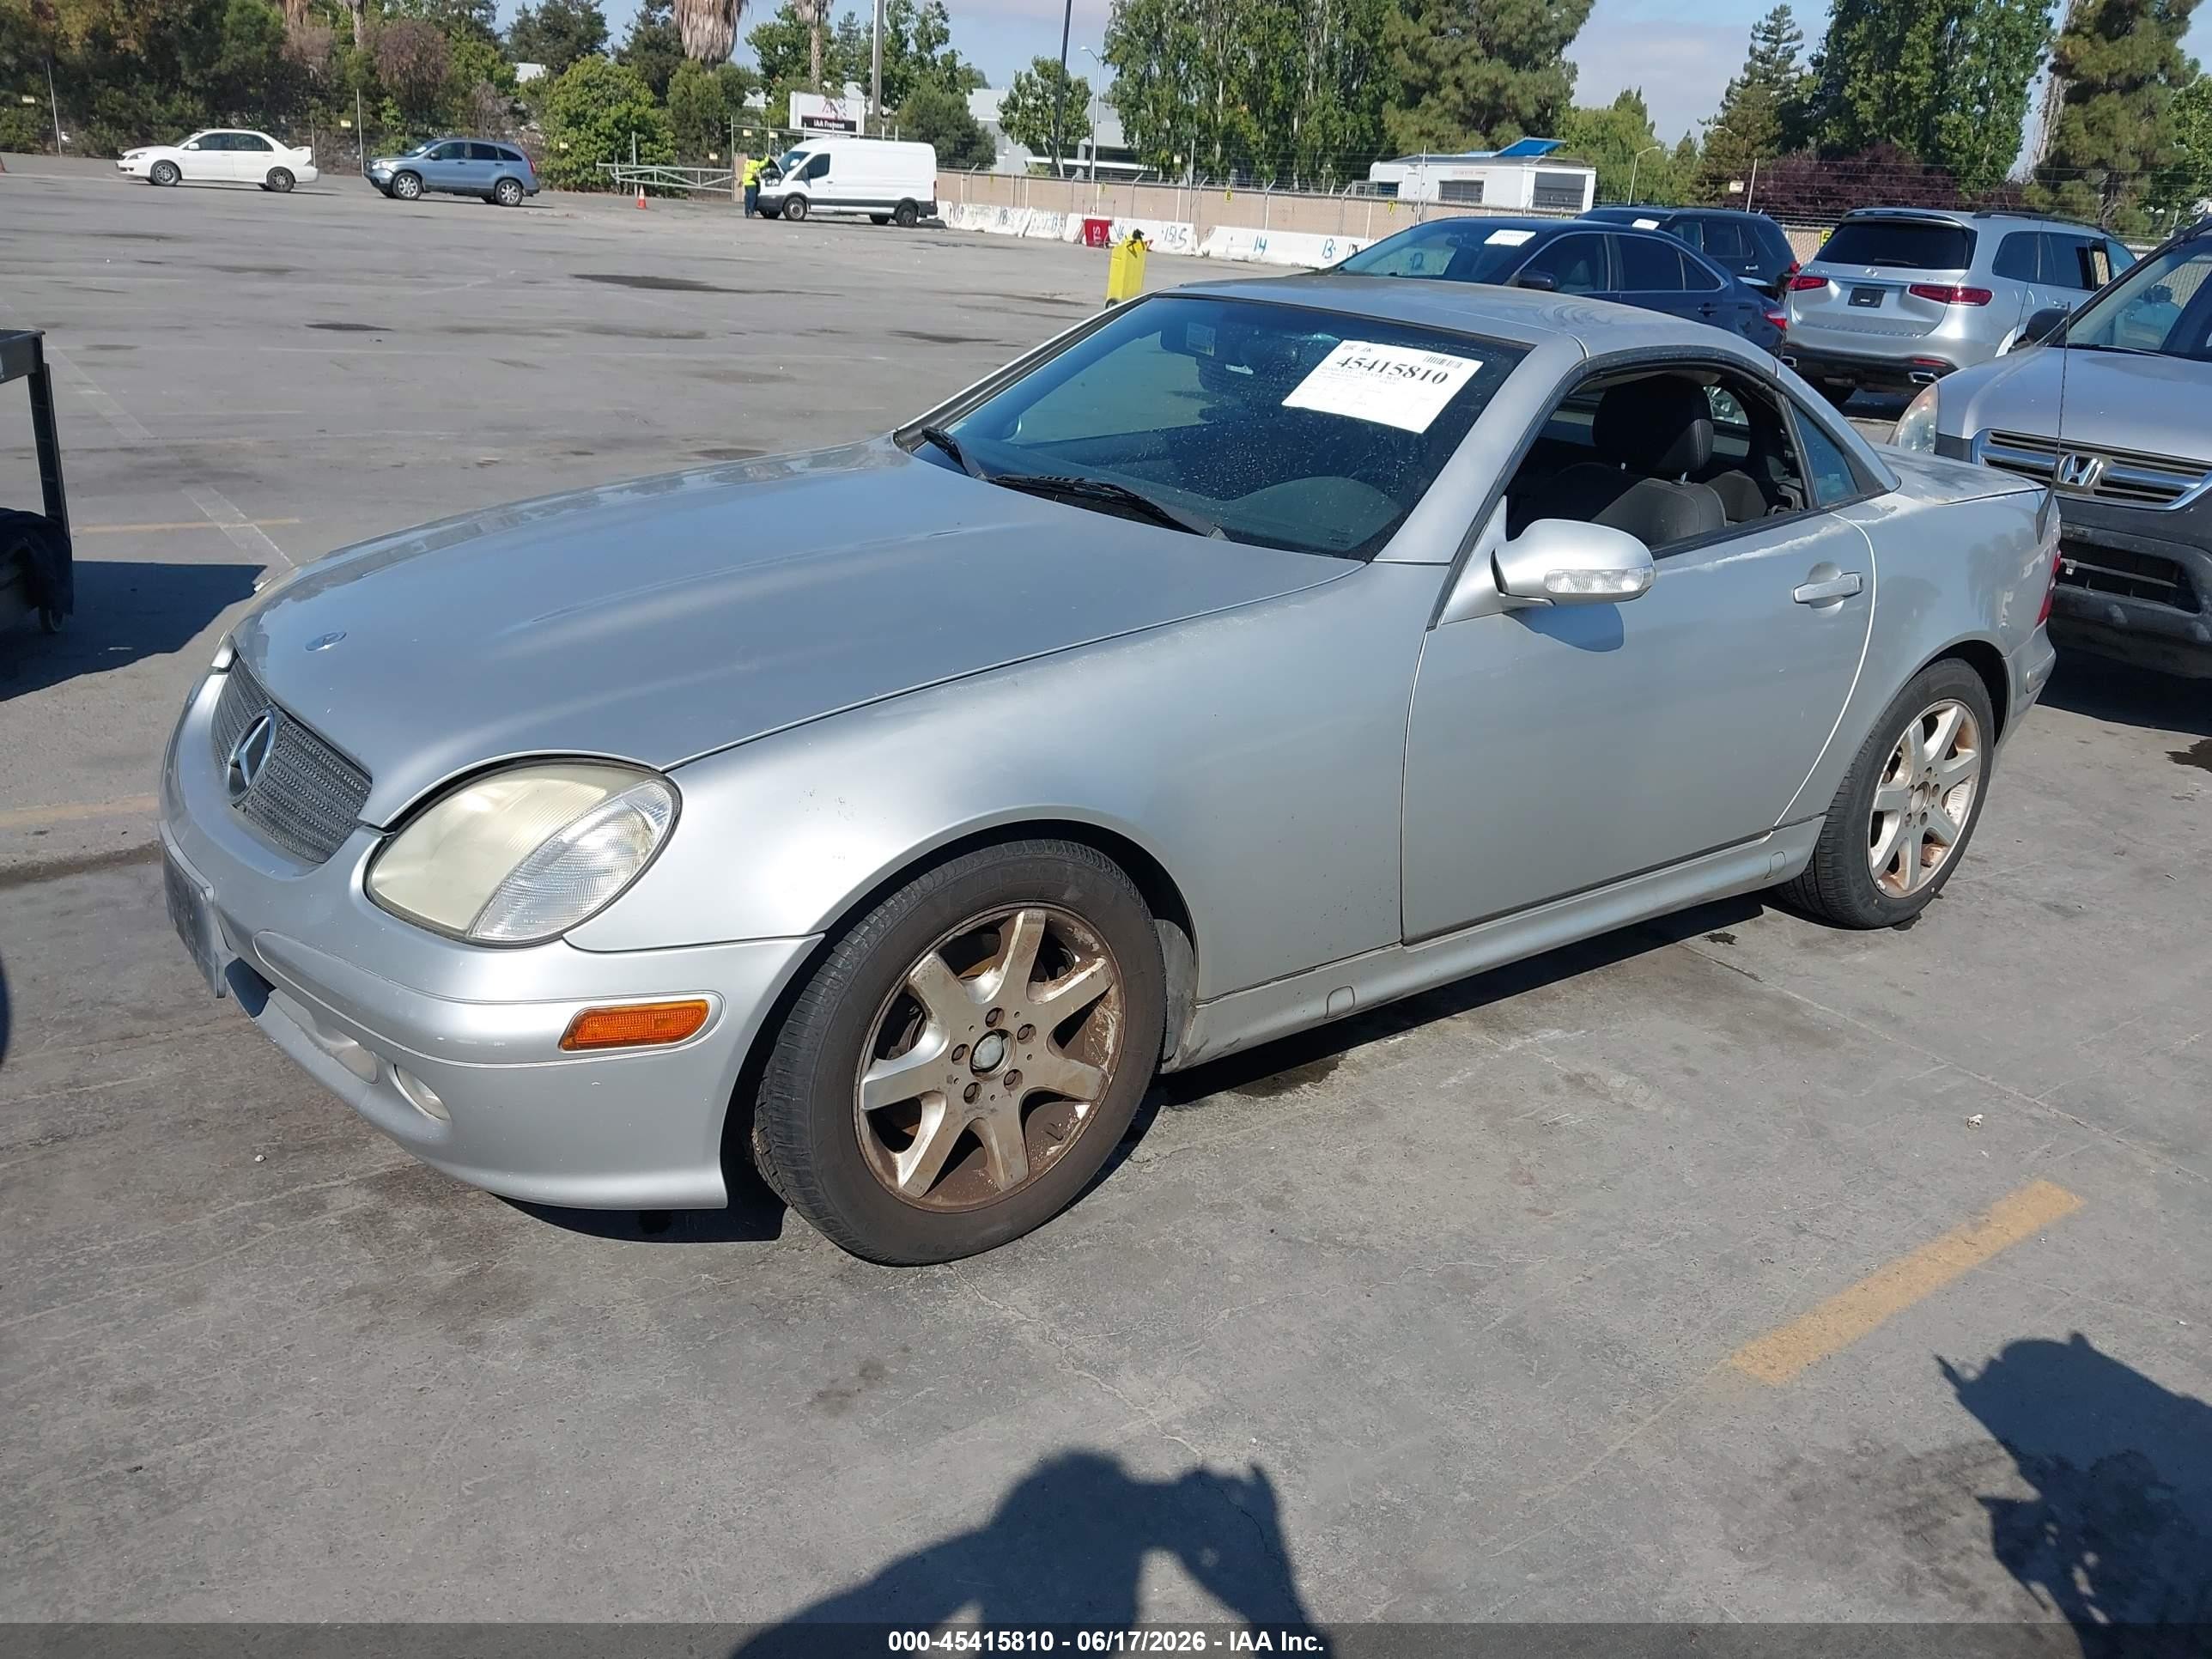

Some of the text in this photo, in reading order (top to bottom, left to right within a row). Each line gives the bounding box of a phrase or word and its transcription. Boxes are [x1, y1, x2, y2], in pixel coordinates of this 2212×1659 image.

[813, 118, 824, 127] IAA
[1389, 202, 1394, 213] 7
[1253, 234, 1268, 257] 14
[1322, 237, 1334, 259] 13
[1335, 356, 1449, 385] 45415810
